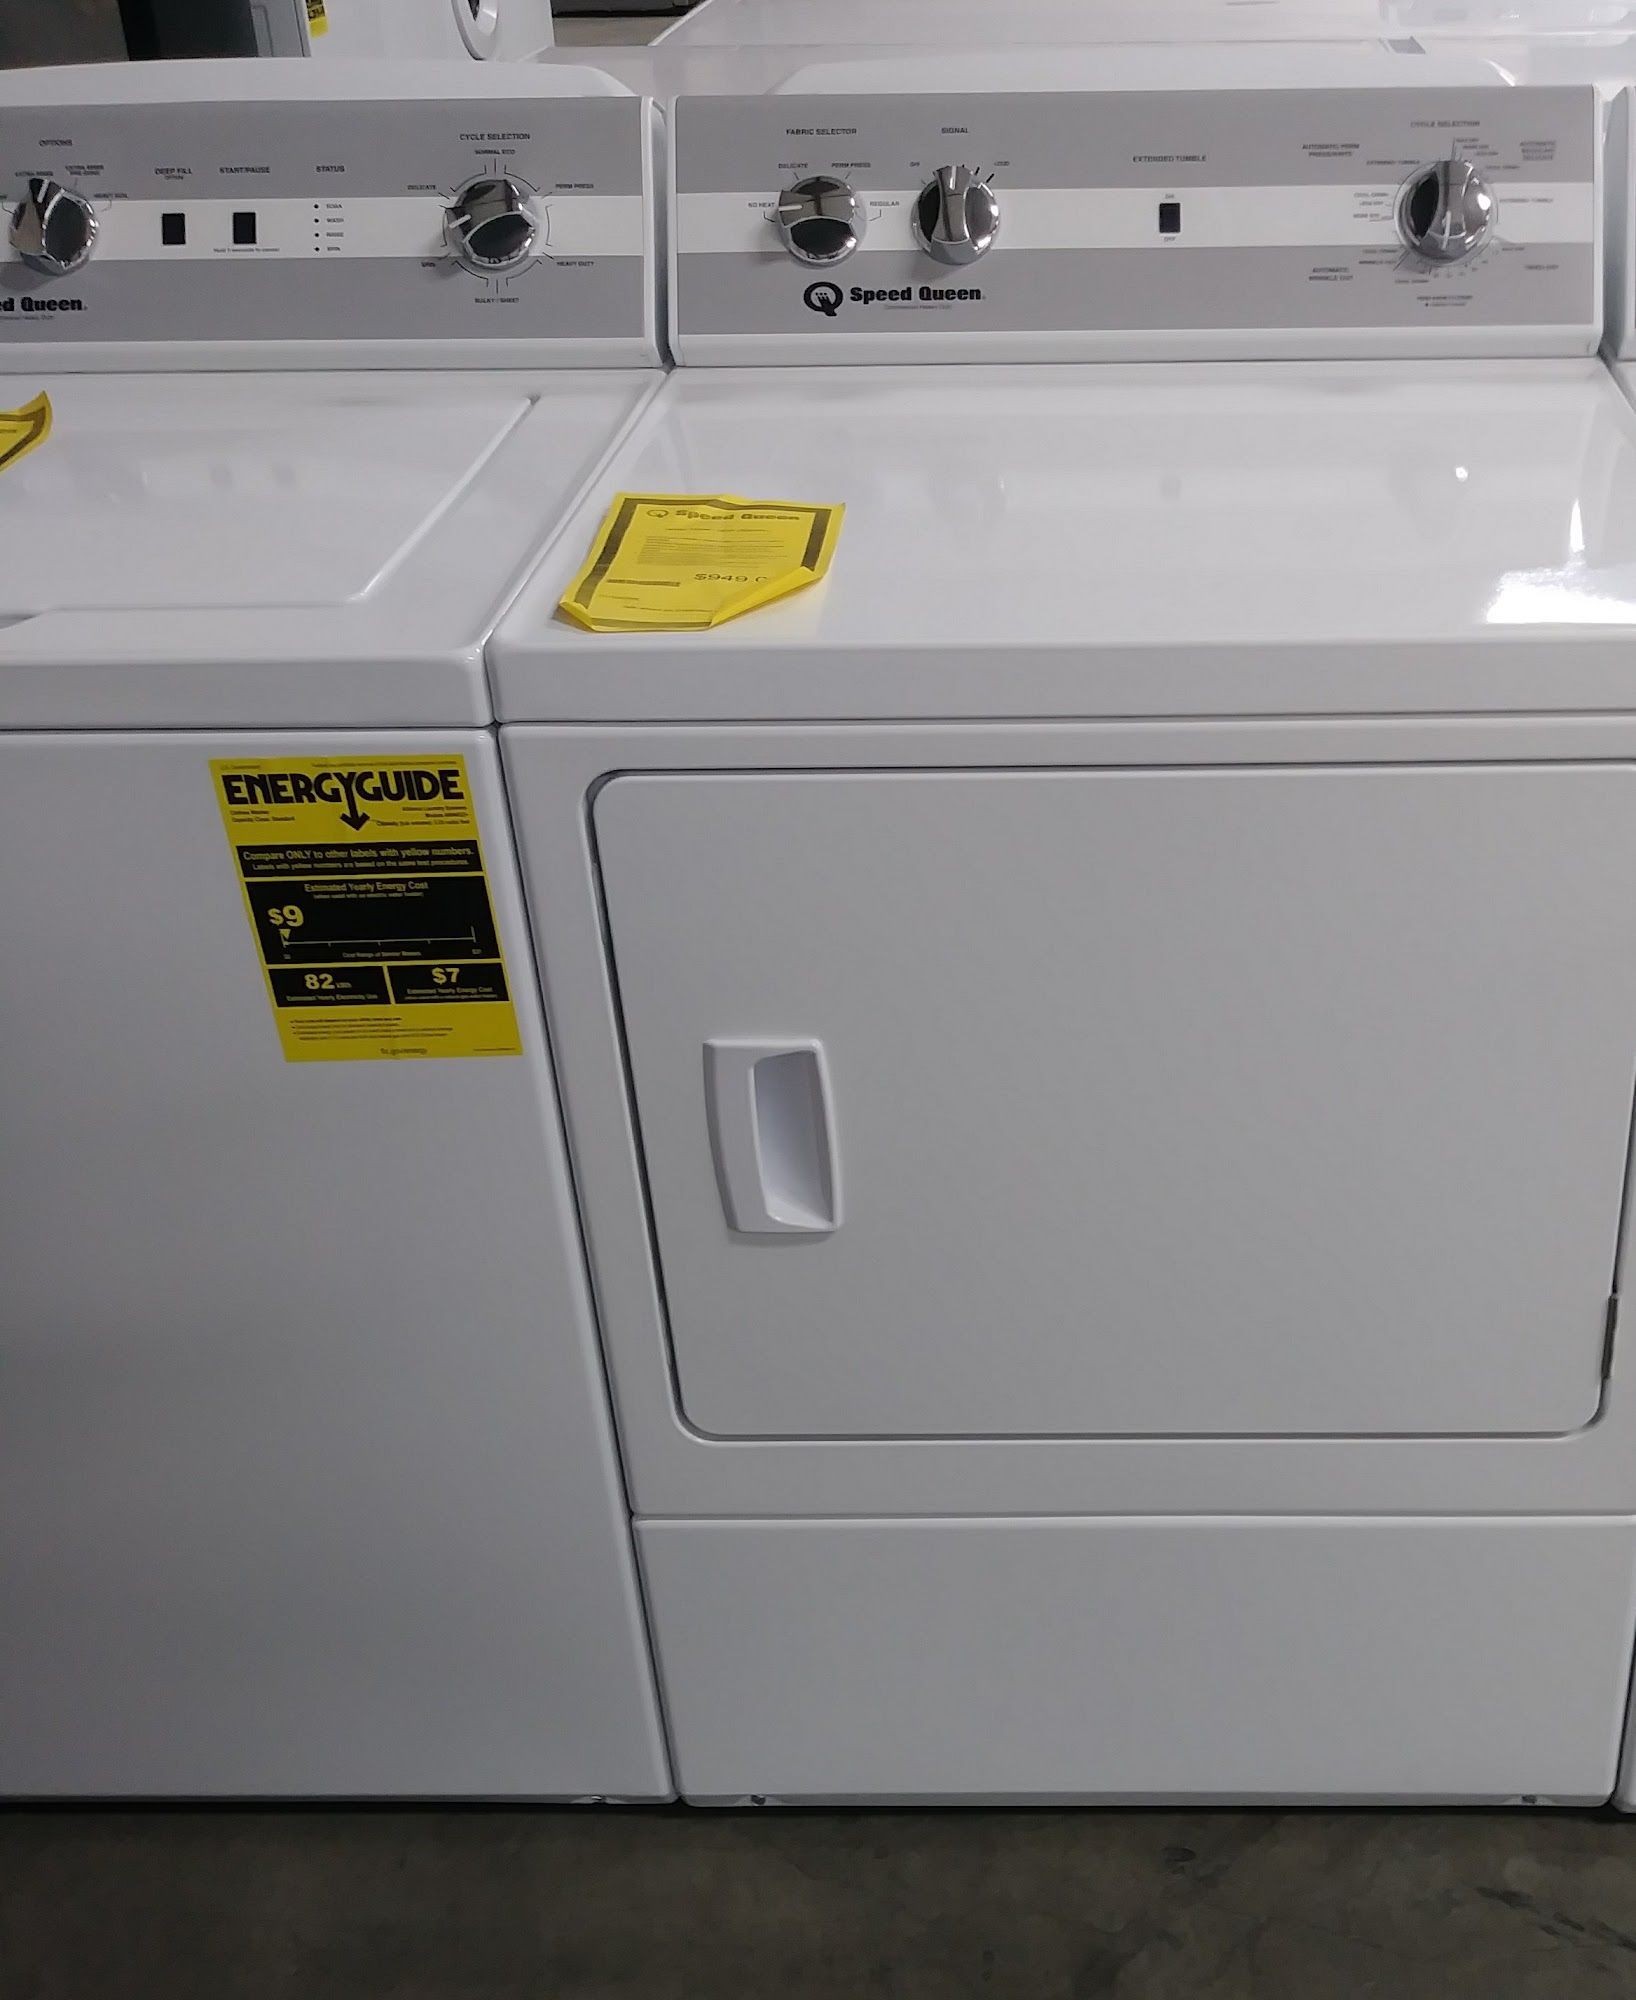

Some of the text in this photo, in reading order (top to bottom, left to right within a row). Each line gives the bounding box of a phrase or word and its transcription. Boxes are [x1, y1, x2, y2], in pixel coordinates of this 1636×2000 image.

[459, 132, 530, 141] CYCLE SELECTION
[786, 127, 857, 136] FABRIC SELECTOR
[941, 127, 969, 135] SIGNAL
[219, 165, 271, 174] START/PAUSE
[316, 165, 346, 173] STATUS
[850, 286, 912, 305] Speed
[919, 286, 982, 302] Queen
[21, 296, 83, 312] Queen
[675, 509, 735, 521] Speed
[740, 513, 800, 521] Queen
[222, 769, 465, 805] ENERGYGUIDE
[243, 851, 285, 861] Compare
[286, 850, 312, 859] ONLY
[314, 850, 324, 859] to
[350, 848, 378, 858] labels
[380, 848, 399, 857] with
[401, 848, 430, 858] yellow
[304, 881, 429, 892] Estimated Yearly Energy Cost
[267, 904, 304, 927] $9
[304, 973, 336, 990] 82
[431, 967, 460, 985] $7
